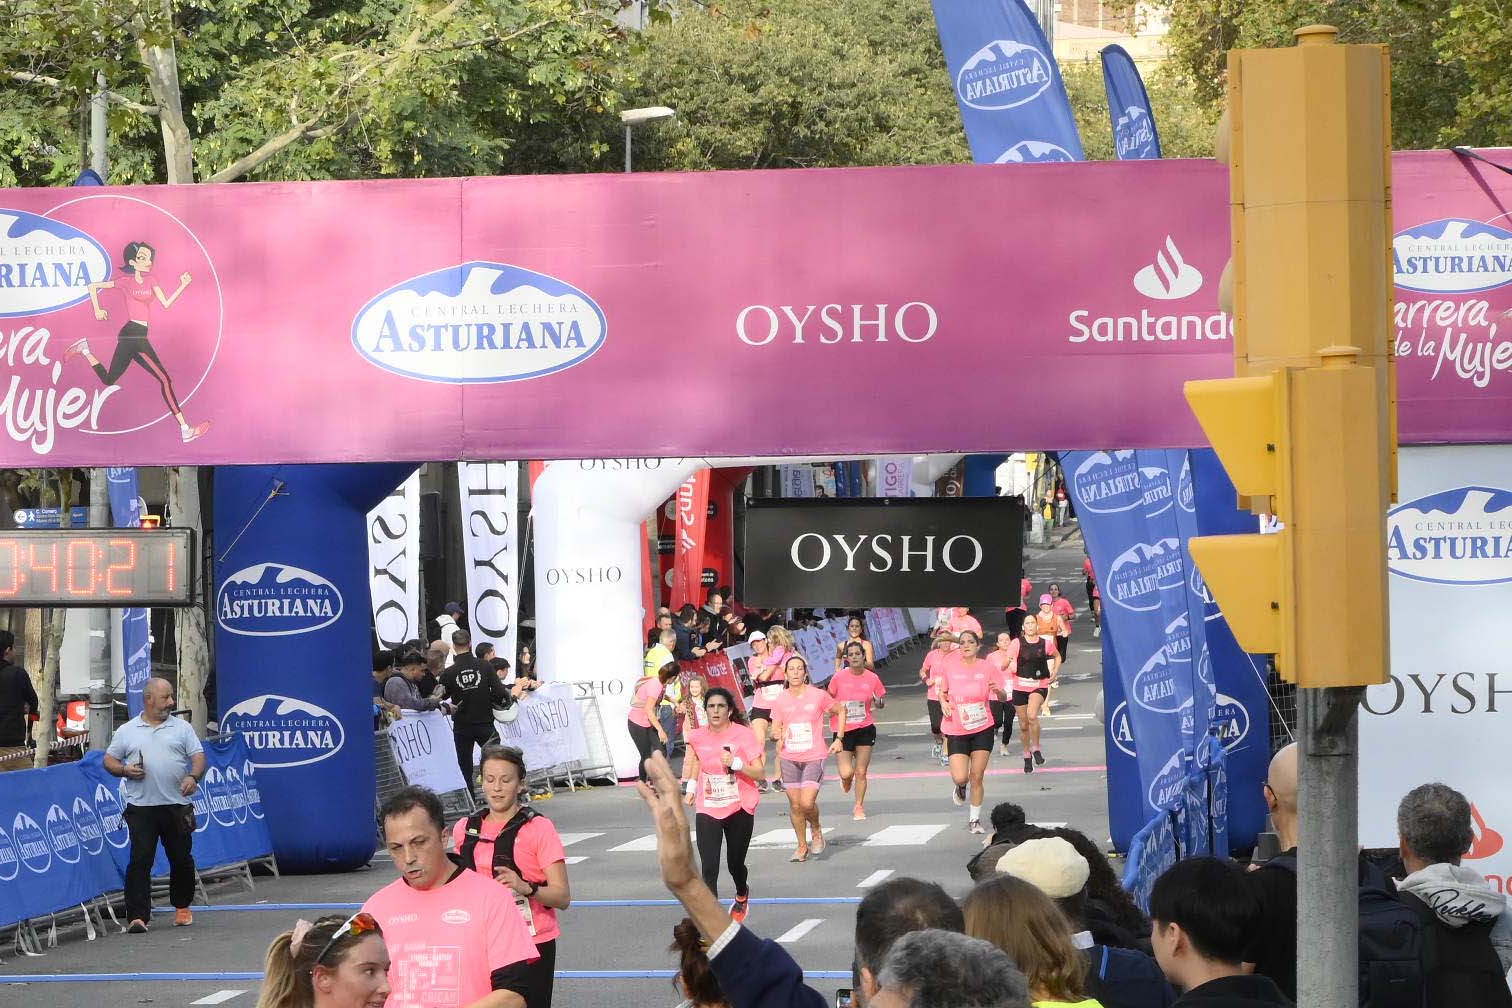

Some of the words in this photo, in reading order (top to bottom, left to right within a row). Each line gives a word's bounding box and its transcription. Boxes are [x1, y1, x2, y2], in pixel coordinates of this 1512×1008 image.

[14, 244, 88, 257] LECHERA
[1408, 243, 1458, 253] CENTRAL
[1463, 242, 1512, 252] LECHER
[409, 303, 491, 317] CENTRAL
[496, 301, 579, 315] LECHERA
[1393, 298, 1491, 329] arrera
[372, 308, 589, 354] ASTURIANA
[735, 300, 940, 347] OYSHO
[1417, 333, 1435, 357] la
[1431, 328, 1512, 388] Muje
[1415, 520, 1483, 532] CENTRAL
[790, 532, 983, 574] OYSHO
[546, 566, 622, 586] OYSHO
[233, 588, 277, 597] CENTRAL
[281, 587, 330, 596] LECHERA
[221, 592, 334, 621] ASTURIANA
[461, 673, 476, 685] BP
[577, 678, 624, 697] SHO
[235, 719, 278, 729] CENTRAL
[281, 719, 332, 728] LECHERA
